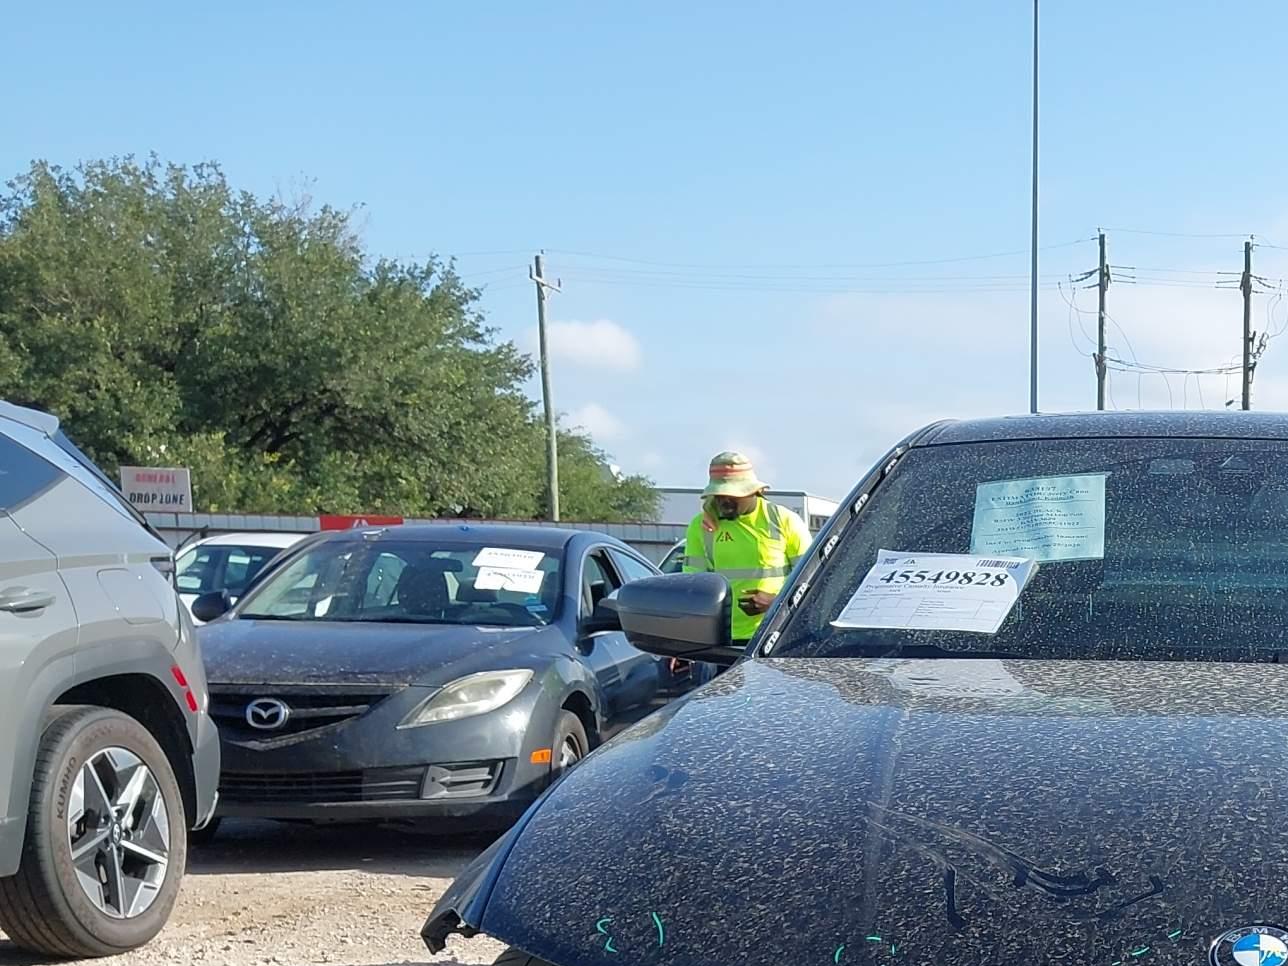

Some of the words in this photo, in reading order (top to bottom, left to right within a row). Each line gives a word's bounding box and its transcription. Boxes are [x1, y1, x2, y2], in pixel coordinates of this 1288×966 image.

[129, 492, 158, 504] DROP
[880, 570, 1009, 587] 45549828
[57, 757, 77, 819] KUMHO
